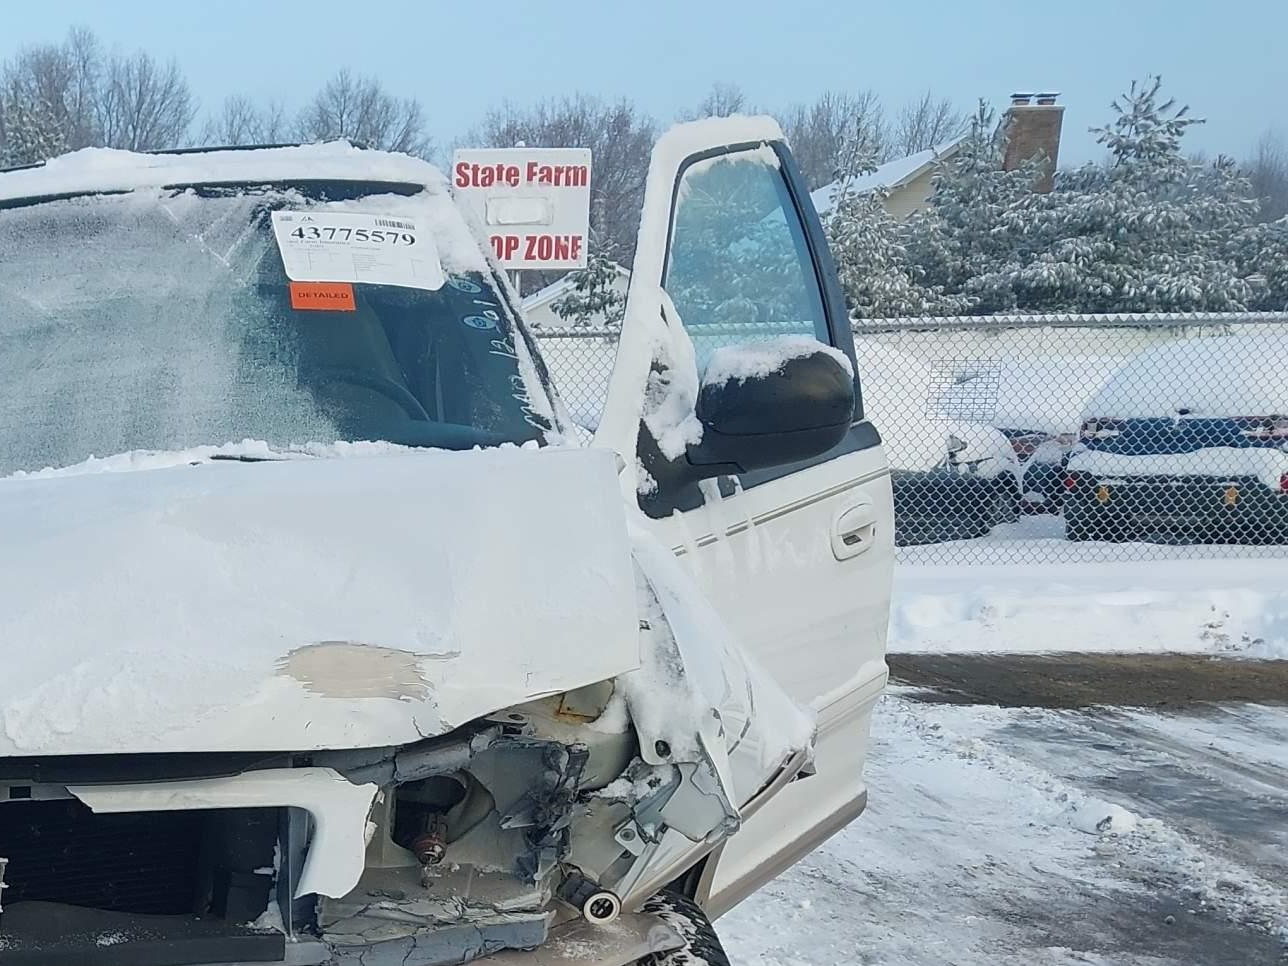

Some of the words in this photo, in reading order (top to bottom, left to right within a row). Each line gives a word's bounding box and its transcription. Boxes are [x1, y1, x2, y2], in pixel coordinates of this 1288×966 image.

[455, 162, 520, 187] State
[526, 162, 587, 187] Farm
[290, 226, 416, 246] 43775579
[524, 235, 583, 260] ZONE
[298, 291, 349, 299] DETAILED
